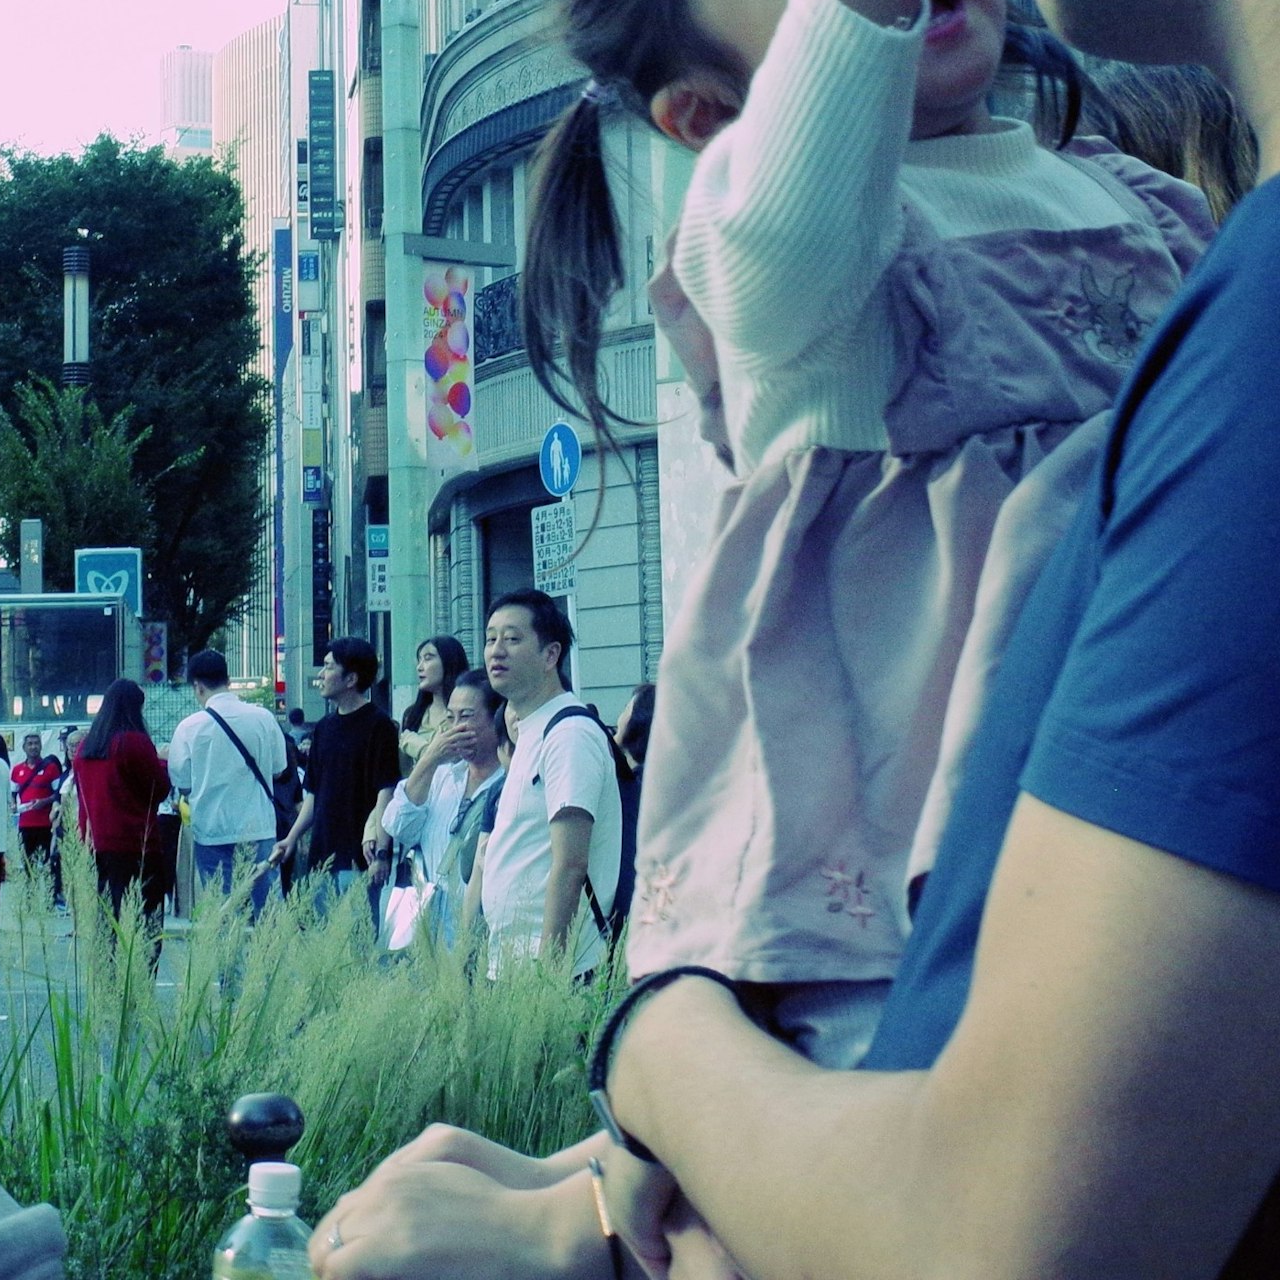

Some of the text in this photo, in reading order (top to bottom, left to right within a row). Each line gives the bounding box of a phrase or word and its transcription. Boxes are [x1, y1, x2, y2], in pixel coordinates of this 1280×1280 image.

[282, 267, 293, 314] MIZUHO
[423, 306, 464, 318] AUTUMN
[423, 318, 452, 328] GINZA
